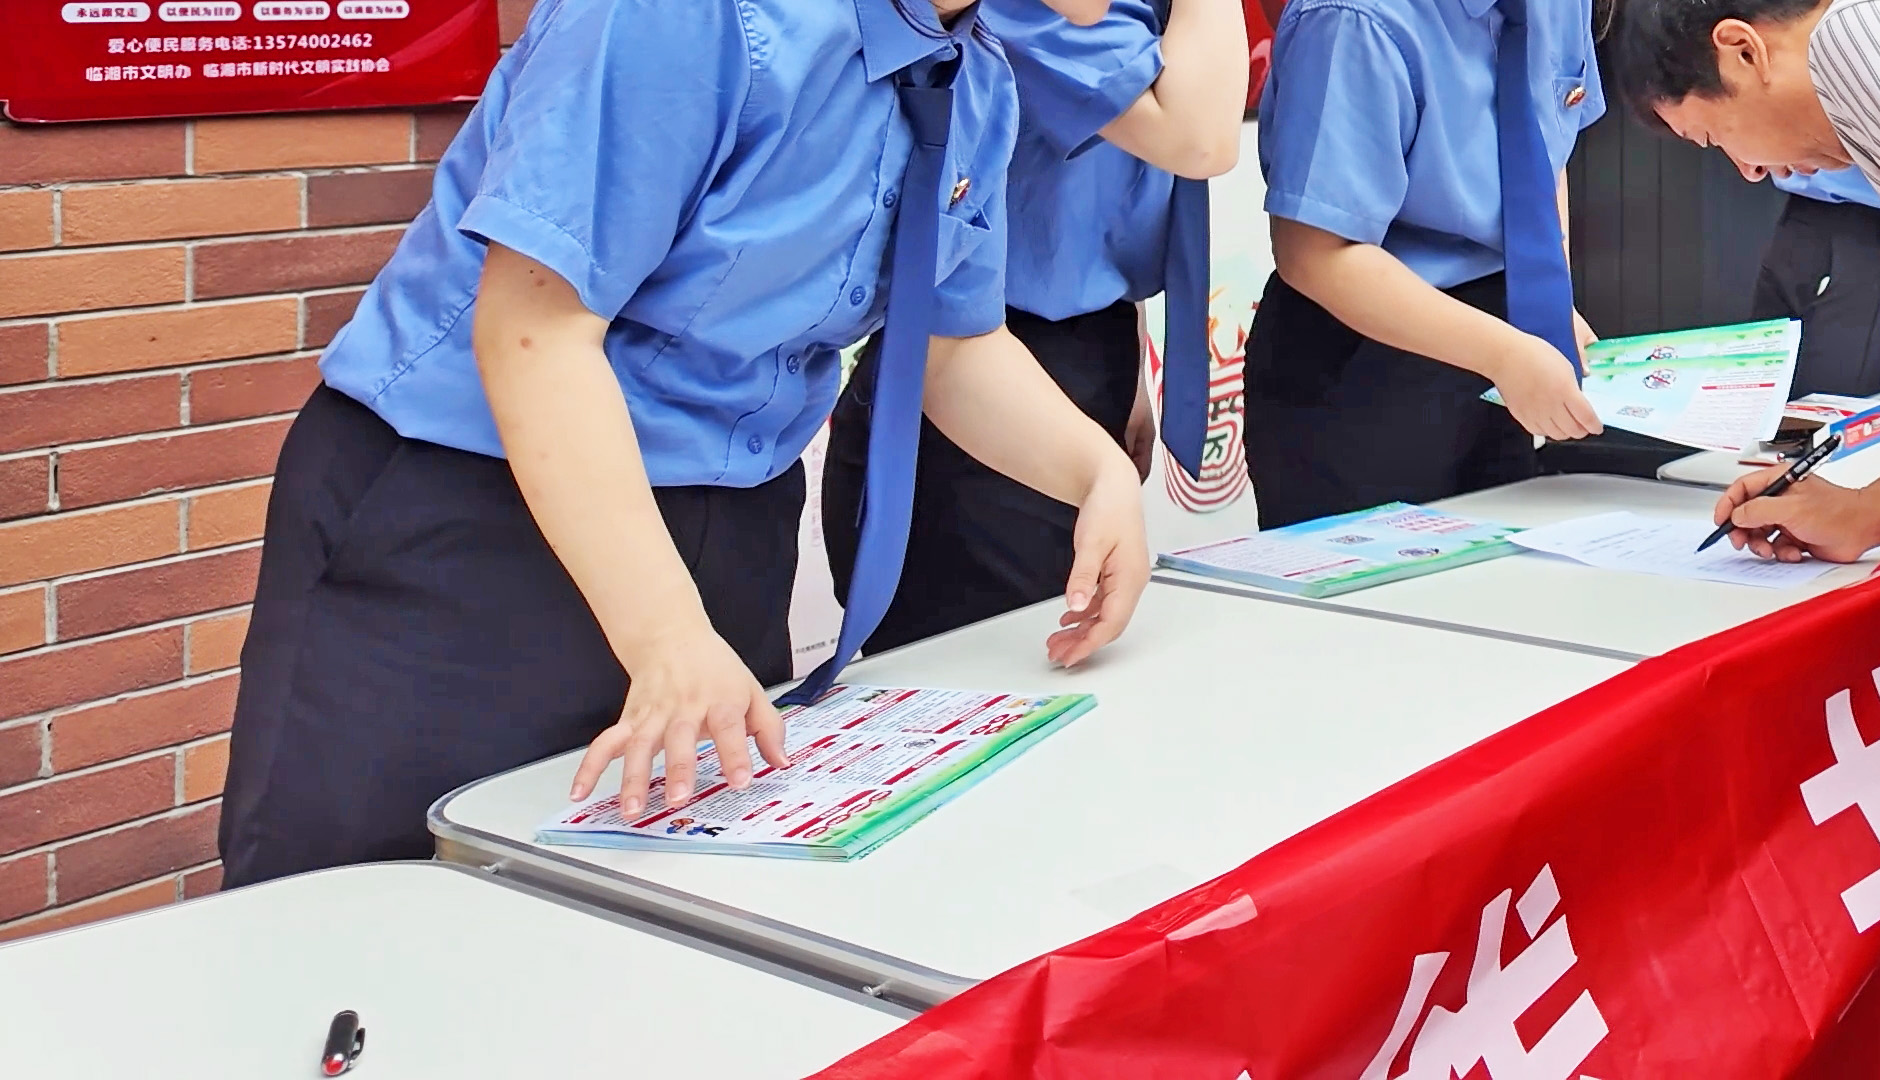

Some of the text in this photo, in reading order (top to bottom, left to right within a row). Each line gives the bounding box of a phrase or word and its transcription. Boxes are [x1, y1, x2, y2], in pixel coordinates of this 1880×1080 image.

[85, 57, 390, 82] 临湘市文明办 临湘市新时代文明实践协会
